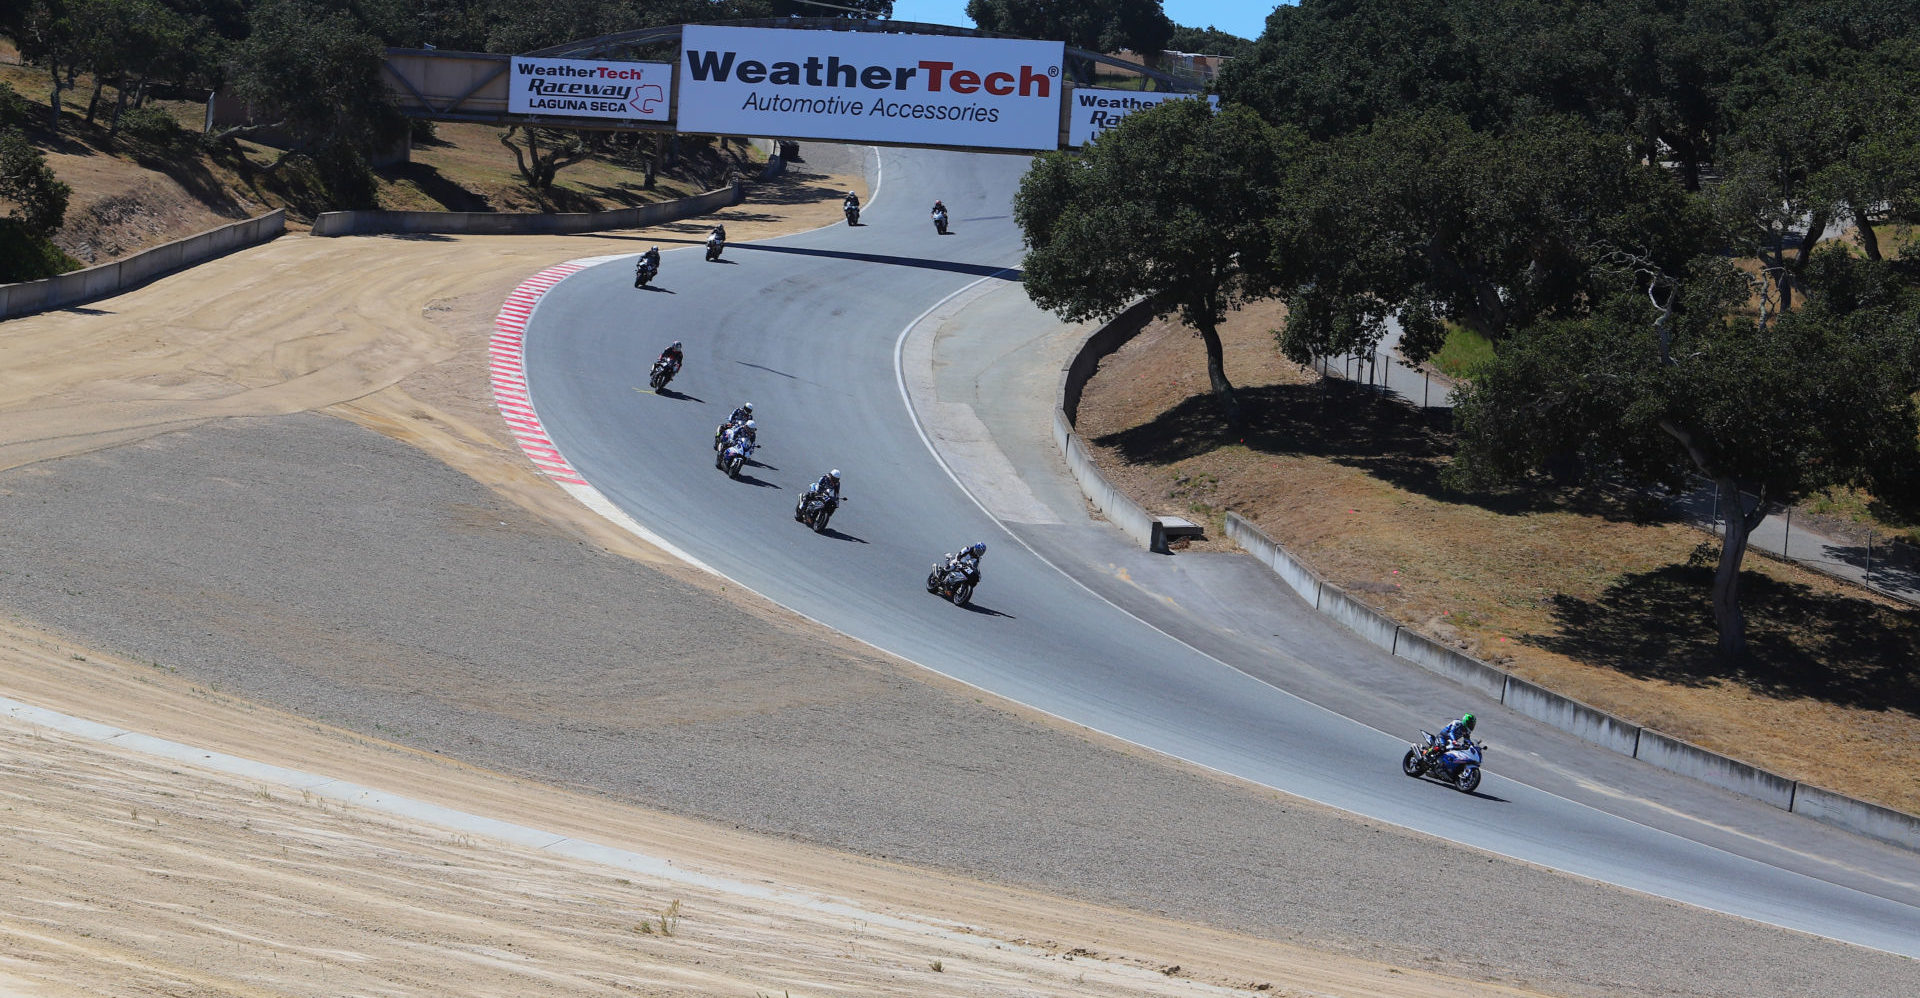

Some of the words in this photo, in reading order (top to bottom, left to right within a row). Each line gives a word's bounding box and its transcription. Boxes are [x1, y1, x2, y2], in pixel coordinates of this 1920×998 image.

[528, 78, 631, 99] Raceway
[529, 98, 588, 111] LAGUNA
[590, 101, 627, 113] SECA
[742, 92, 863, 116] Automotive
[870, 98, 999, 123] Accessories
